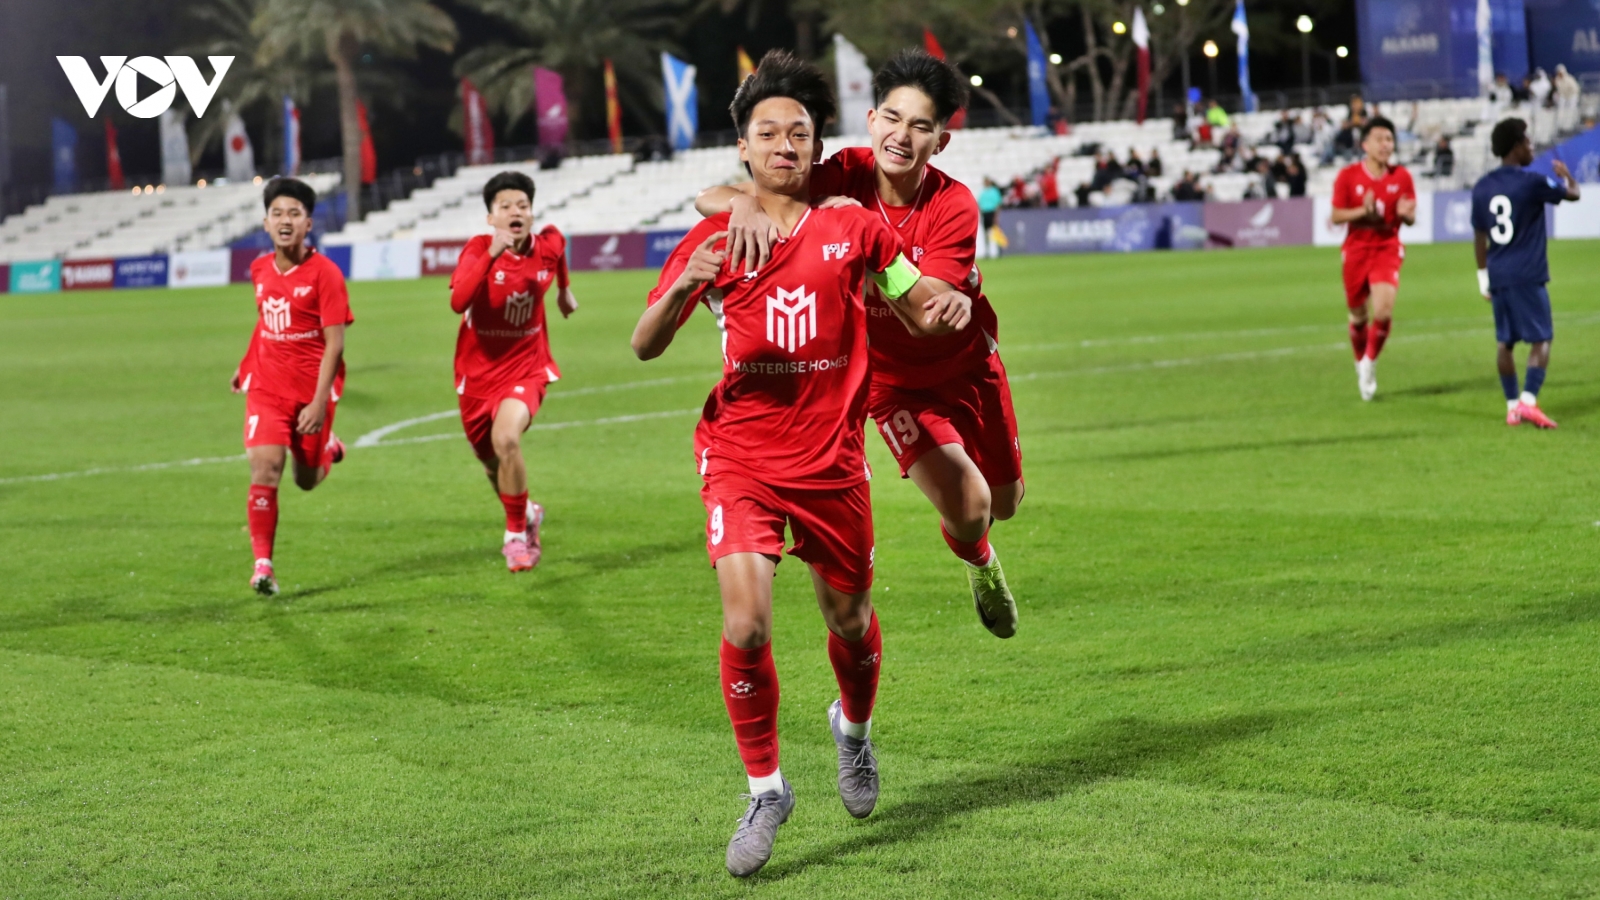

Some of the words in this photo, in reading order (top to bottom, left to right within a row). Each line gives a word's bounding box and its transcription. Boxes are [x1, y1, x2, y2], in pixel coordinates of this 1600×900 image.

[1489, 195, 1514, 244] 3
[732, 359, 806, 374] MASTERISE
[808, 355, 848, 372] HOMES
[882, 409, 920, 456] 19
[711, 505, 724, 546] 9
